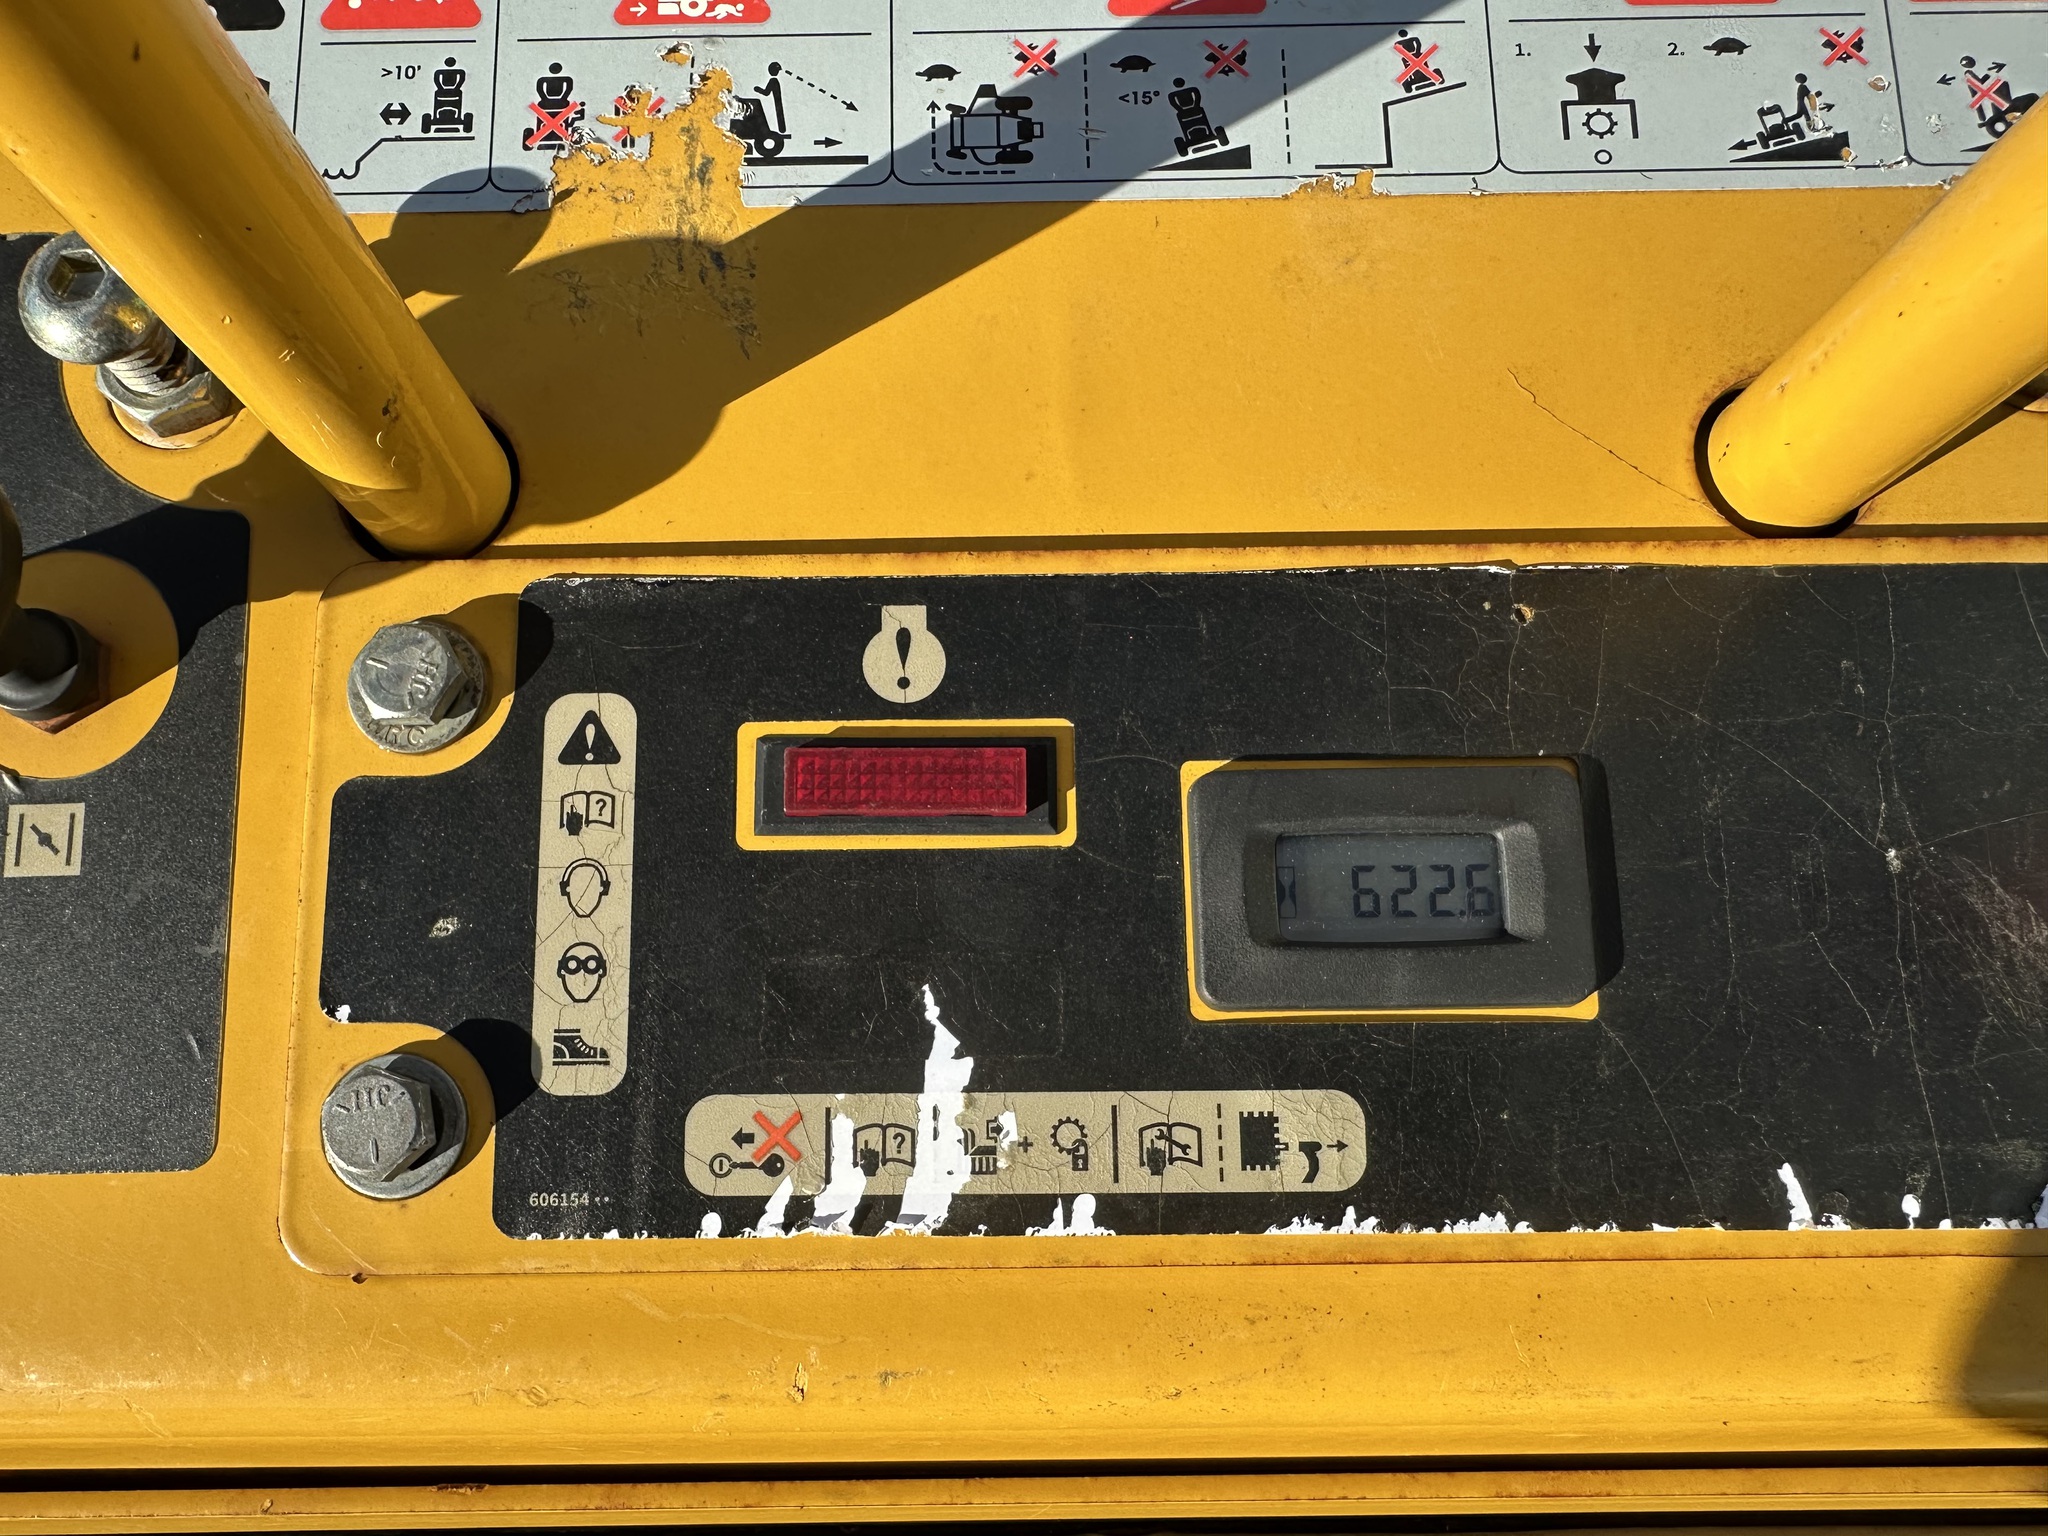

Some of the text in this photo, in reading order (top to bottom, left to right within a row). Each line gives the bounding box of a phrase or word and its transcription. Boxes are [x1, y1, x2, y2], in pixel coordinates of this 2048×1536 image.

[1515, 43, 1532, 57] 1.
[1667, 42, 1686, 56] 2.
[1351, 864, 1496, 918] 622.6
[529, 1192, 590, 1207] 606154
